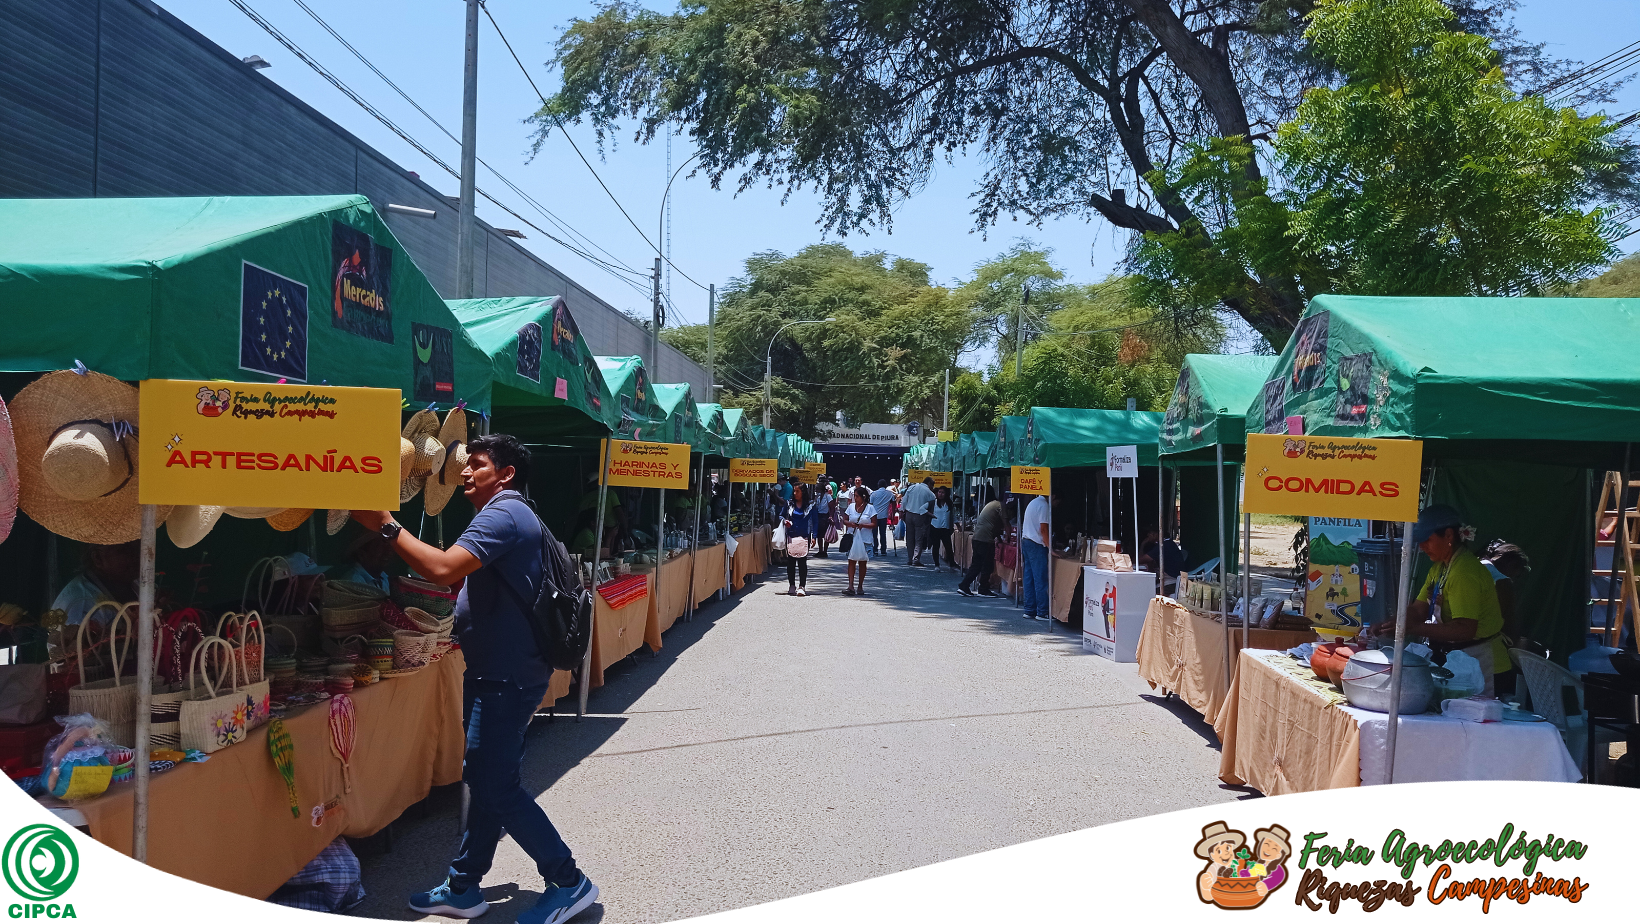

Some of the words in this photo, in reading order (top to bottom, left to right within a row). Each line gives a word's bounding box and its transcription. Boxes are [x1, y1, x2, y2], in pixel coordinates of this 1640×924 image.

[232, 404, 277, 420] Riquezas
[841, 432, 871, 440] NACIONAL
[165, 449, 383, 474] ARTESANÍAS
[613, 459, 667, 470] HARINAS
[608, 468, 683, 479] MENESTRAS
[1263, 475, 1400, 498] COMIDAS
[1313, 516, 1362, 528] PANFILA
